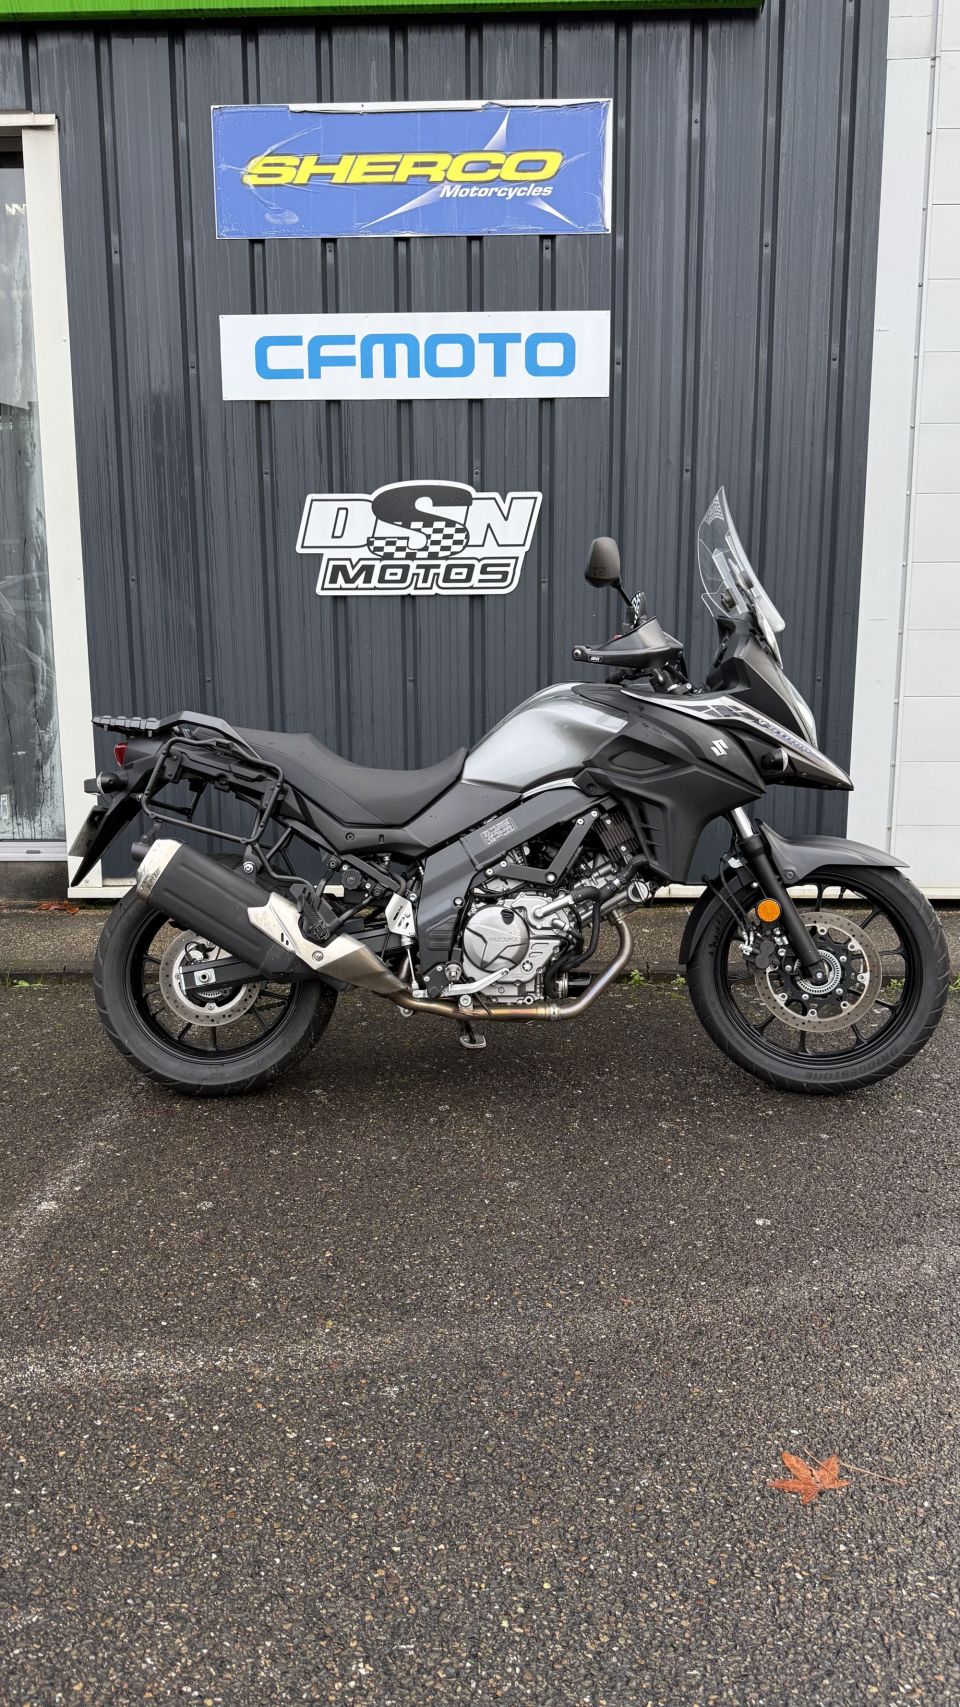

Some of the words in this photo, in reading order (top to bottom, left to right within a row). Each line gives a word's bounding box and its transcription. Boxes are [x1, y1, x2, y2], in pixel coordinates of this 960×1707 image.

[243, 151, 565, 186] SHERCO
[439, 183, 553, 200] Motorcycles
[254, 332, 576, 380] CFMOTO
[301, 484, 538, 559] DSN
[327, 562, 512, 585] MOTOS
